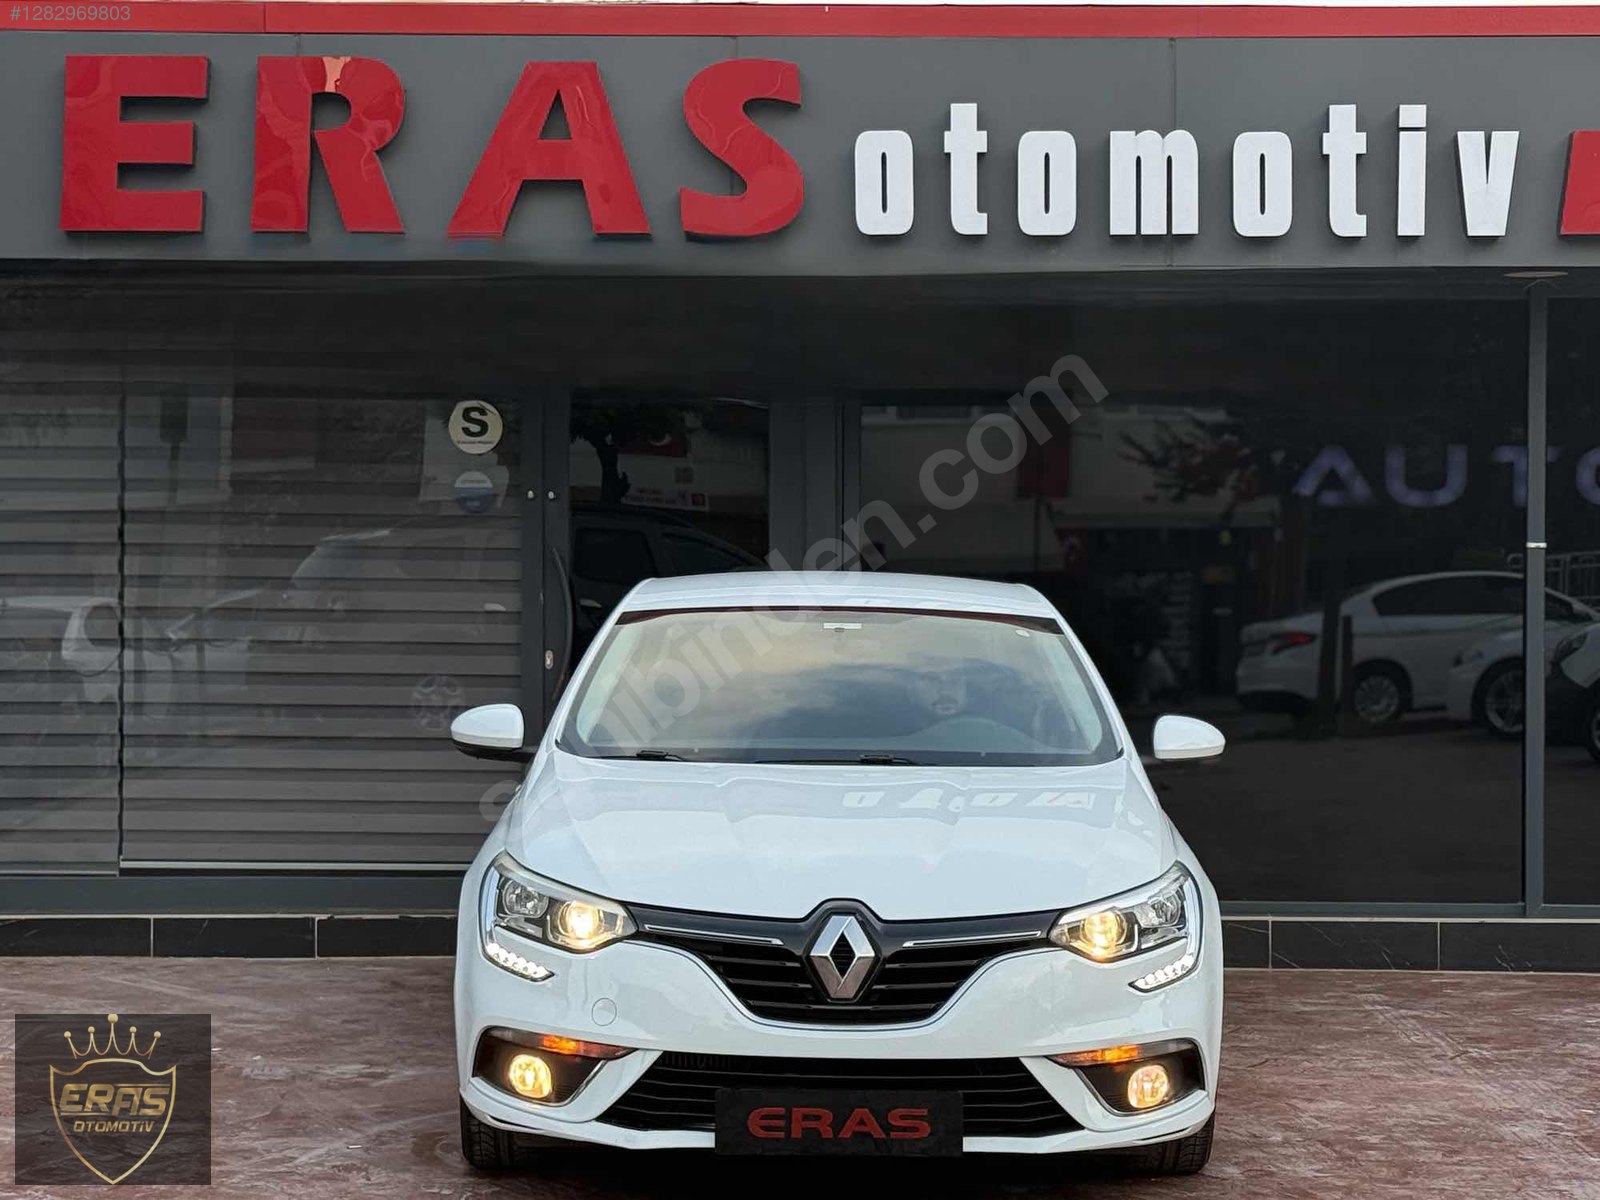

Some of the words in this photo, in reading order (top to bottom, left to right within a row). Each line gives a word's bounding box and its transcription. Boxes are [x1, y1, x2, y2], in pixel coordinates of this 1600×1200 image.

[61, 55, 805, 238] ERAS
[854, 103, 1520, 237] otomotiv
[461, 406, 490, 438] S
[747, 1107, 931, 1139] ERAS
